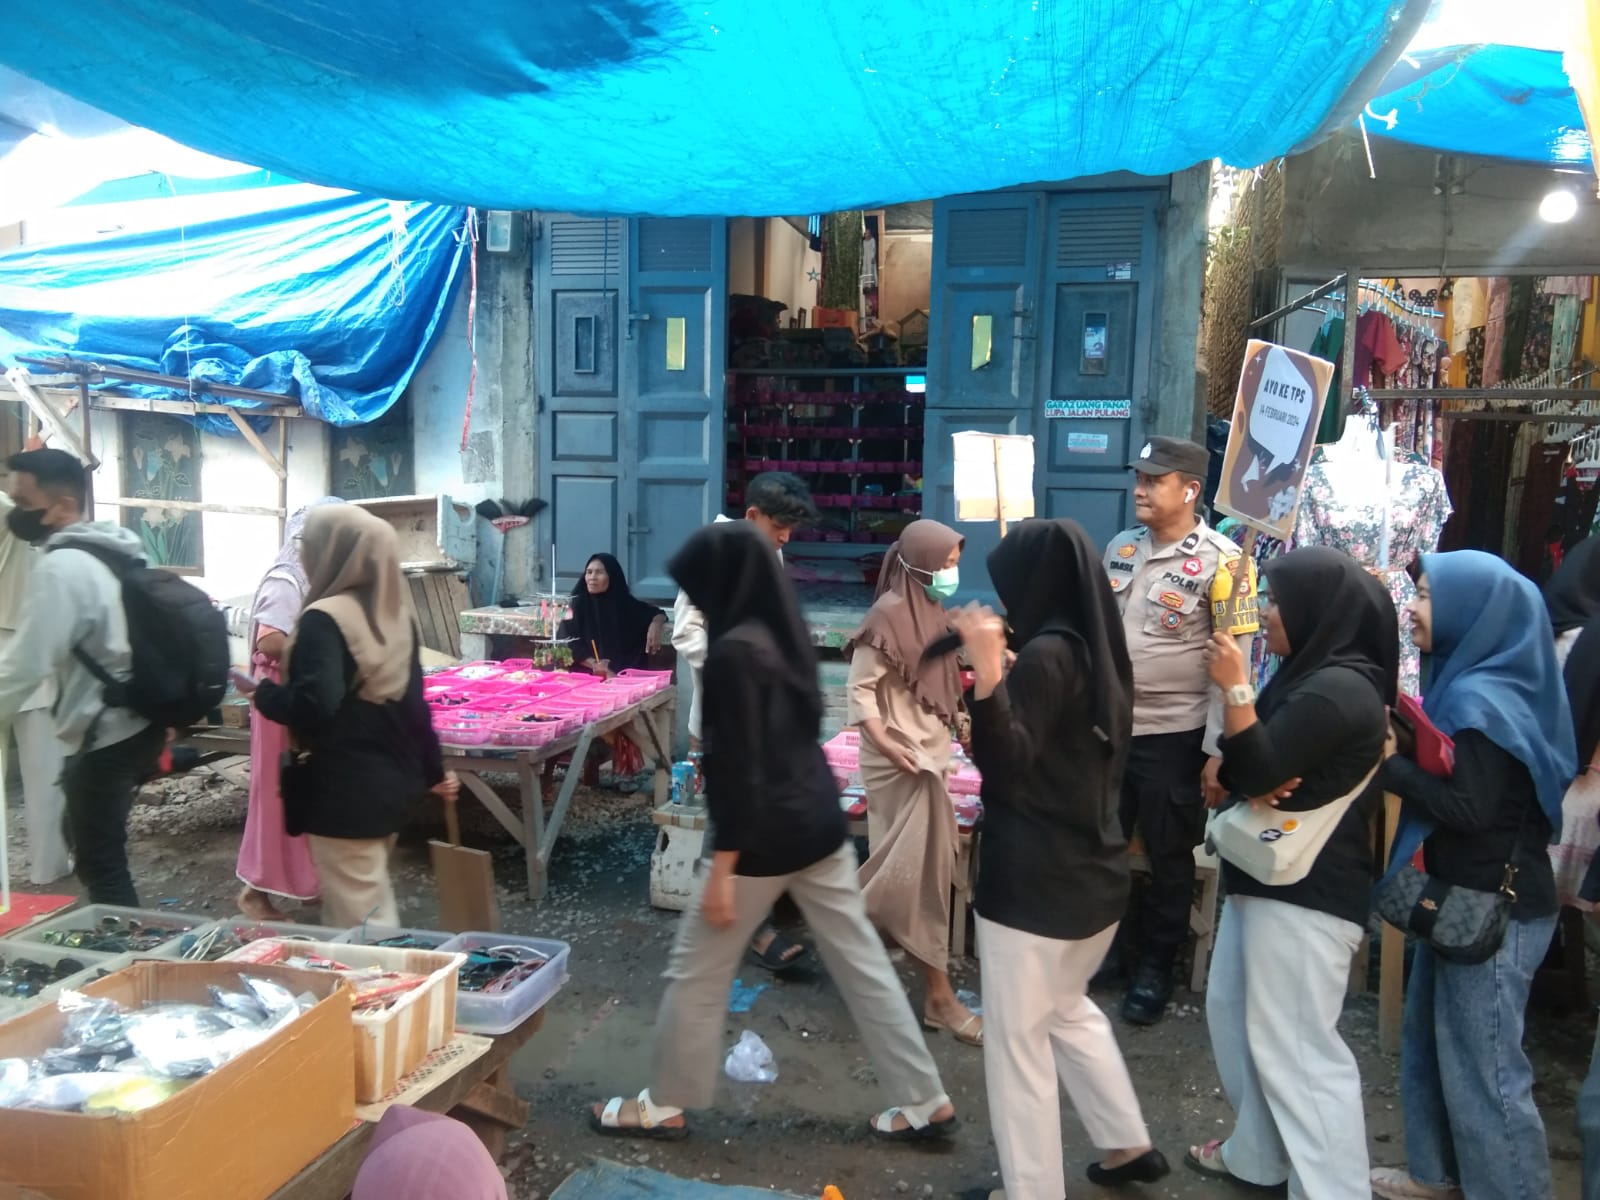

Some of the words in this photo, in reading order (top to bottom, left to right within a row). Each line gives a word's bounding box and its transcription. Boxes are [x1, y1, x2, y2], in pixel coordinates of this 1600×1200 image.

[1264, 379, 1279, 396] AYO
[1278, 383, 1290, 399] KE
[1290, 386, 1306, 403] TPS
[1045, 409, 1065, 417] LUPA
[1068, 409, 1093, 417] JALAN
[1095, 409, 1129, 417] PULANG
[1076, 401, 1101, 409] UANG
[1264, 406, 1287, 423] FEBRUARI
[1286, 414, 1300, 427] 2024
[1162, 571, 1200, 593] POLRI
